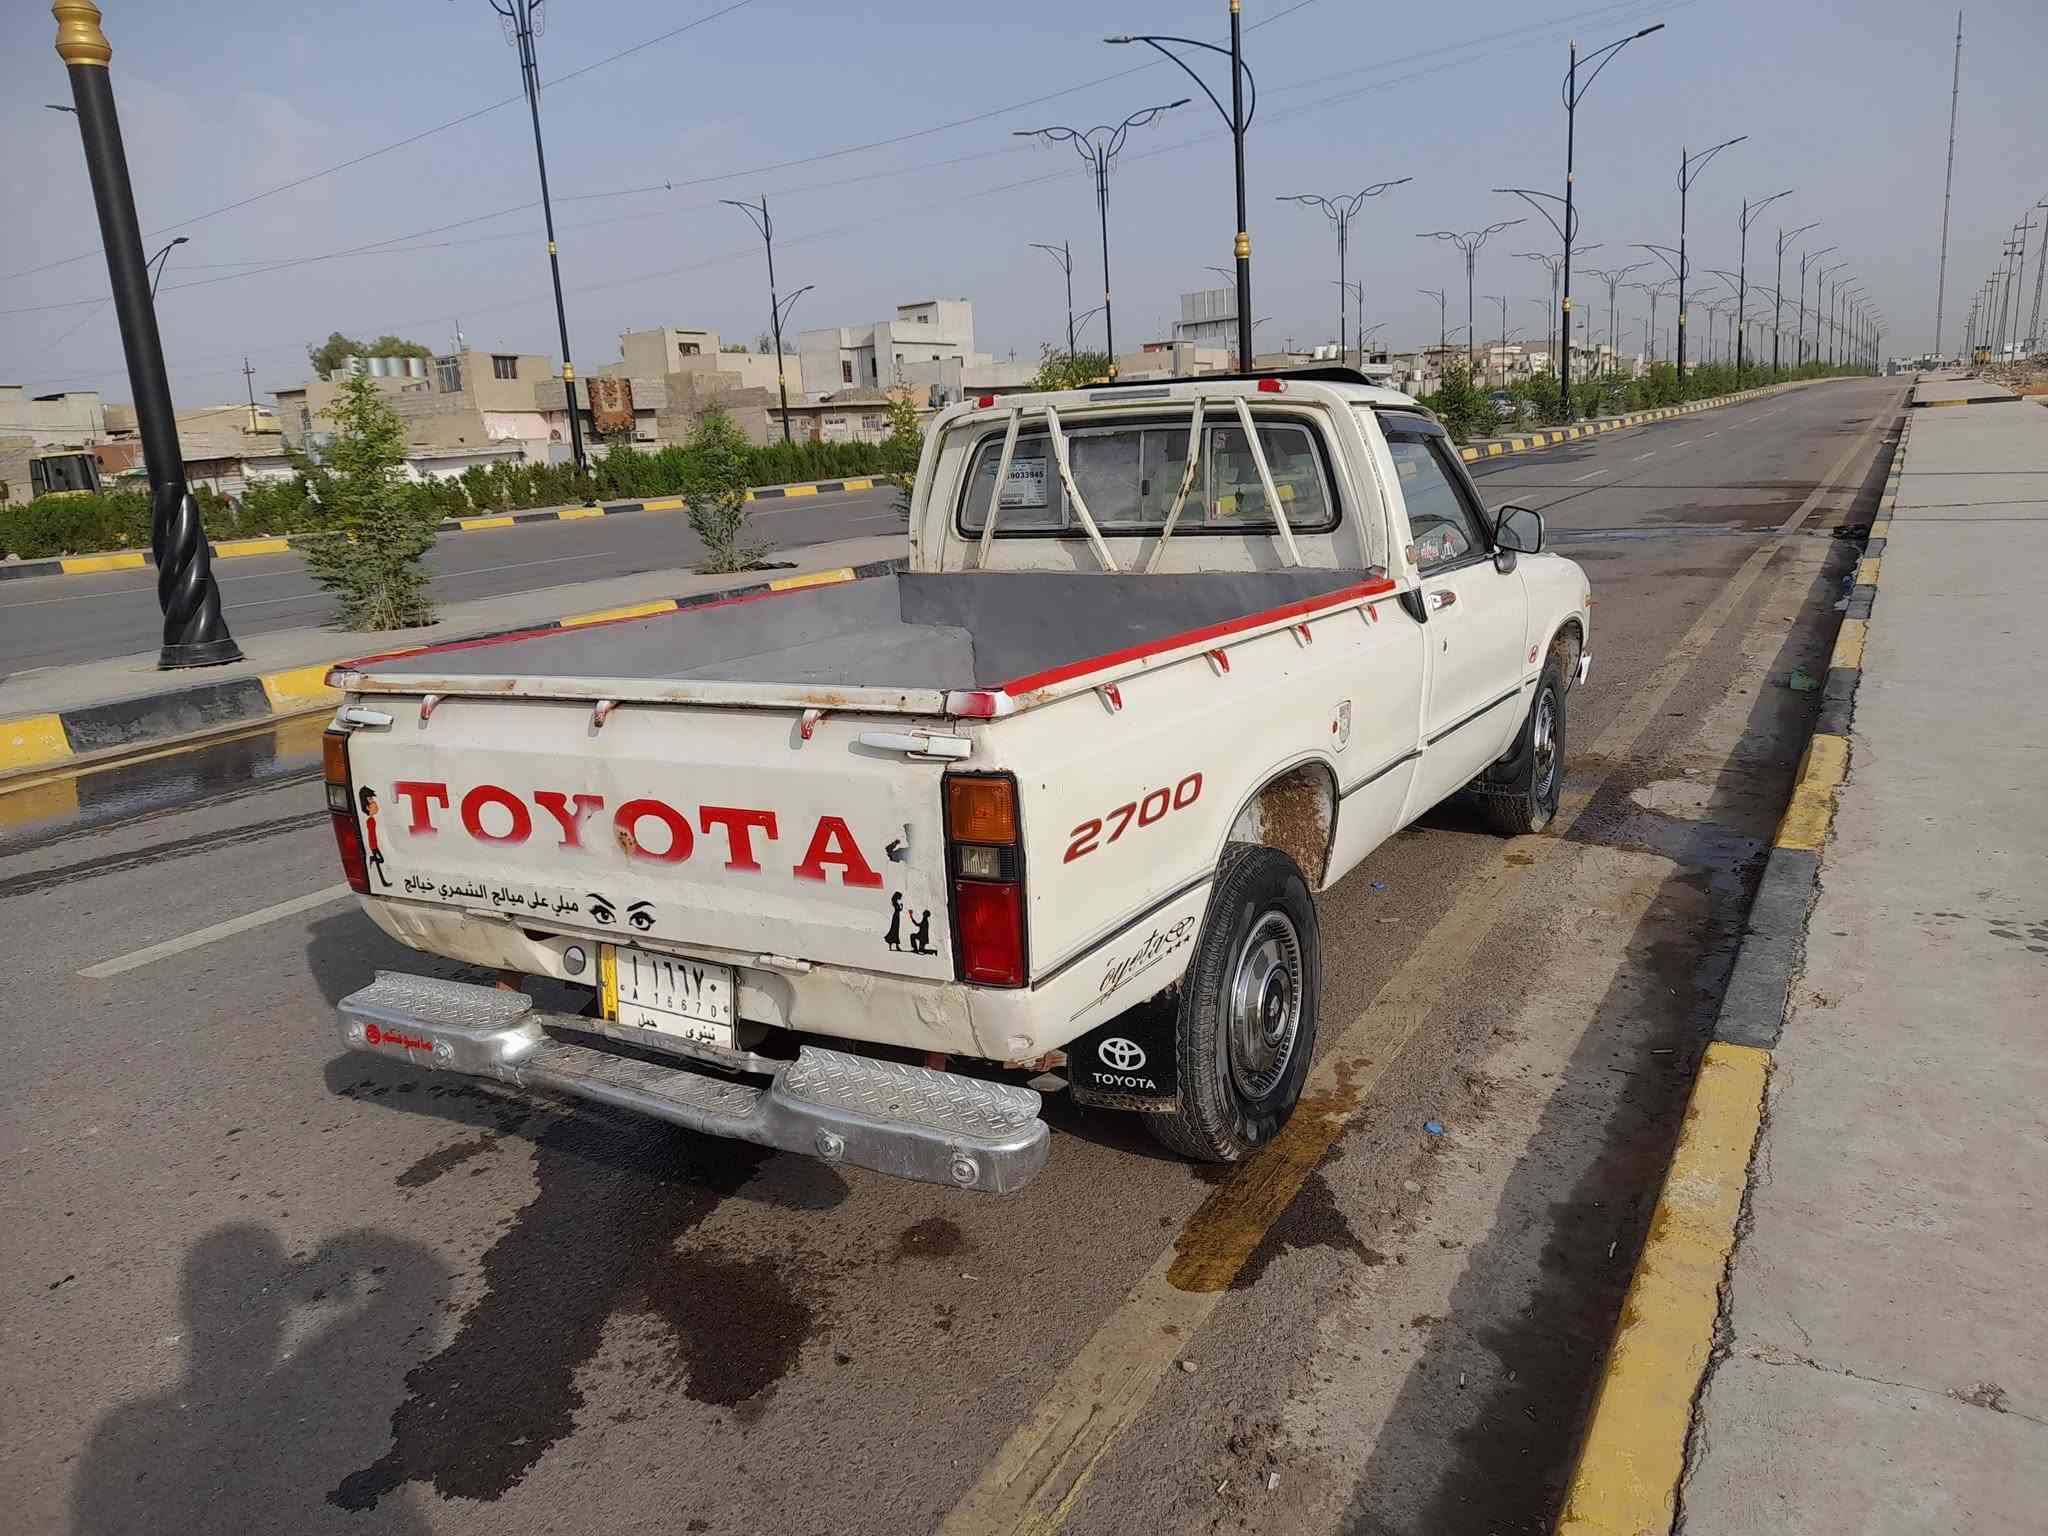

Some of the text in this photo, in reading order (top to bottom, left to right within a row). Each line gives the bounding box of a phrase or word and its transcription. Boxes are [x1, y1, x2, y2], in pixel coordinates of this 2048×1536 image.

[1062, 771, 1203, 864] 2700
[392, 779, 885, 890] TOYOTA
[438, 881, 487, 900] الشمري
[527, 891, 548, 909] على
[1092, 1072, 1157, 1090] TOYOTA
